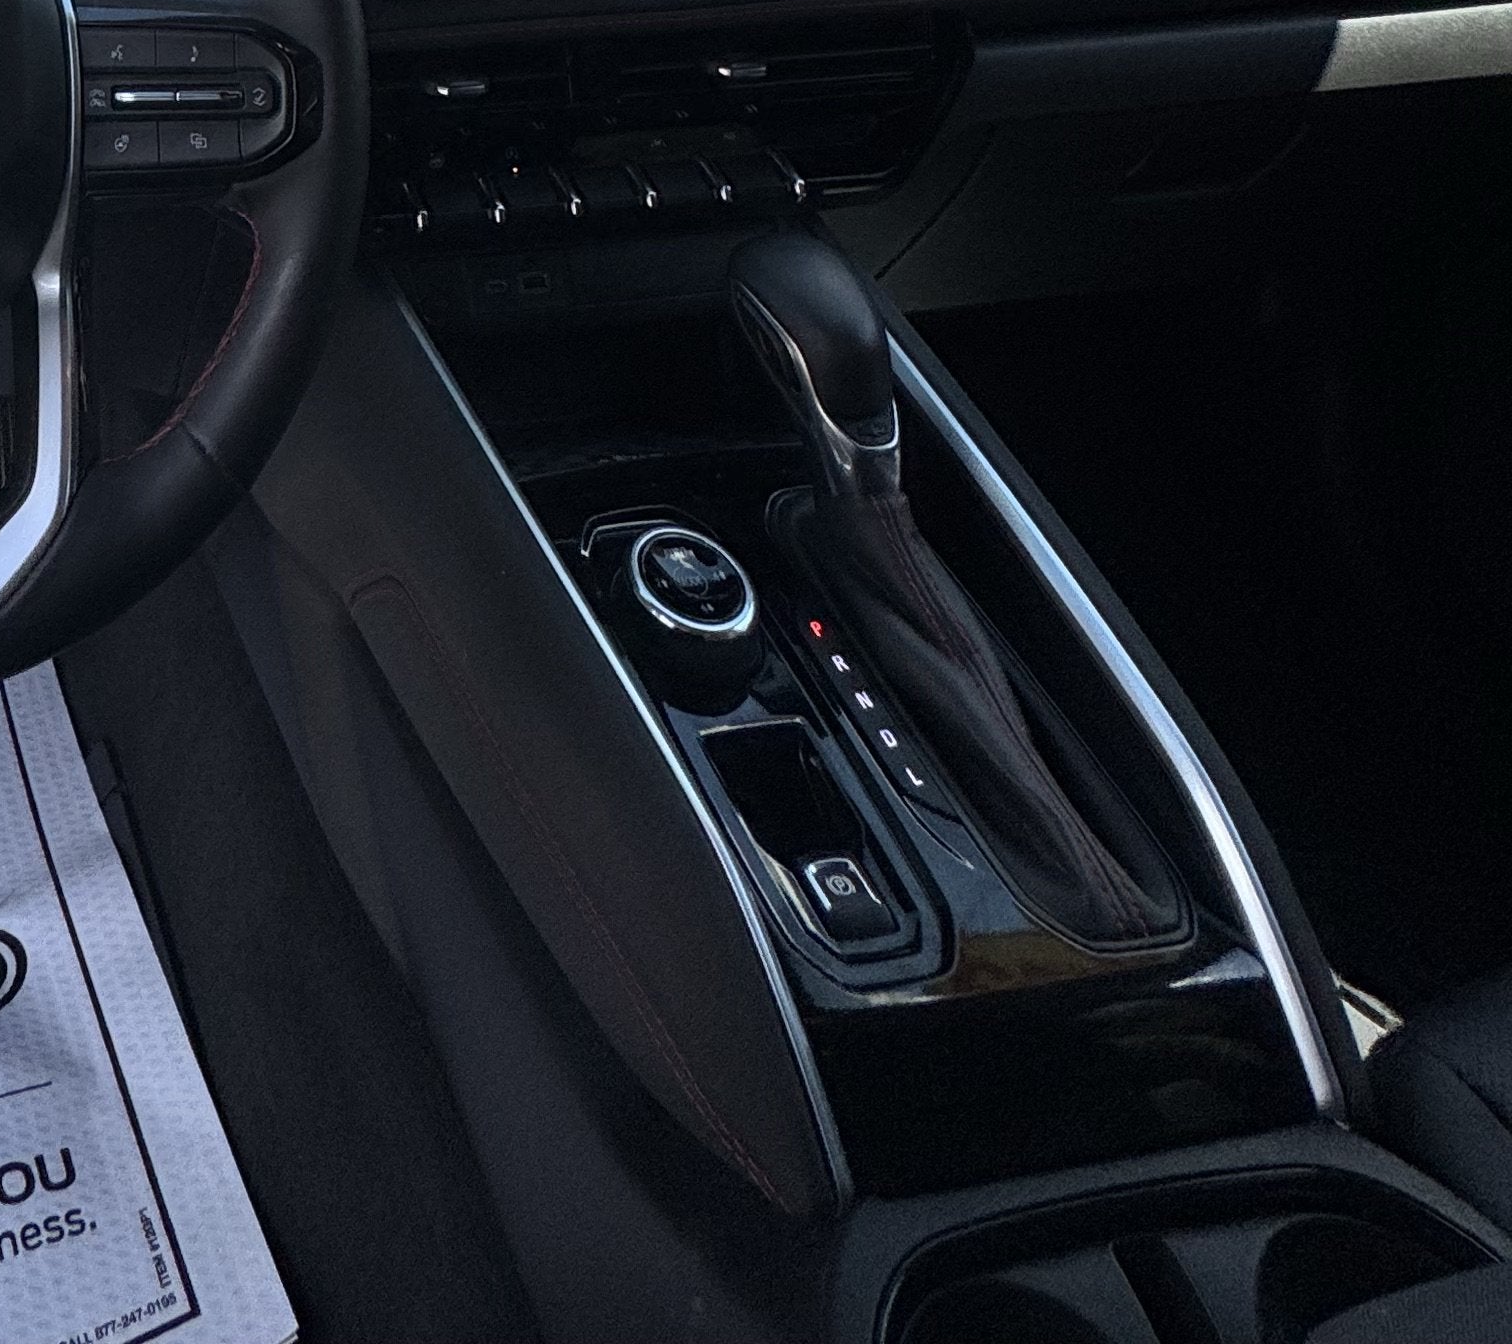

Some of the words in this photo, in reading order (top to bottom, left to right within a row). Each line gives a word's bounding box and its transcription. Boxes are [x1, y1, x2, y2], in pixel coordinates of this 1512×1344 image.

[809, 621, 822, 638] P
[831, 654, 851, 673] R
[854, 691, 874, 710] N
[879, 729, 898, 749] D
[904, 766, 924, 787] L
